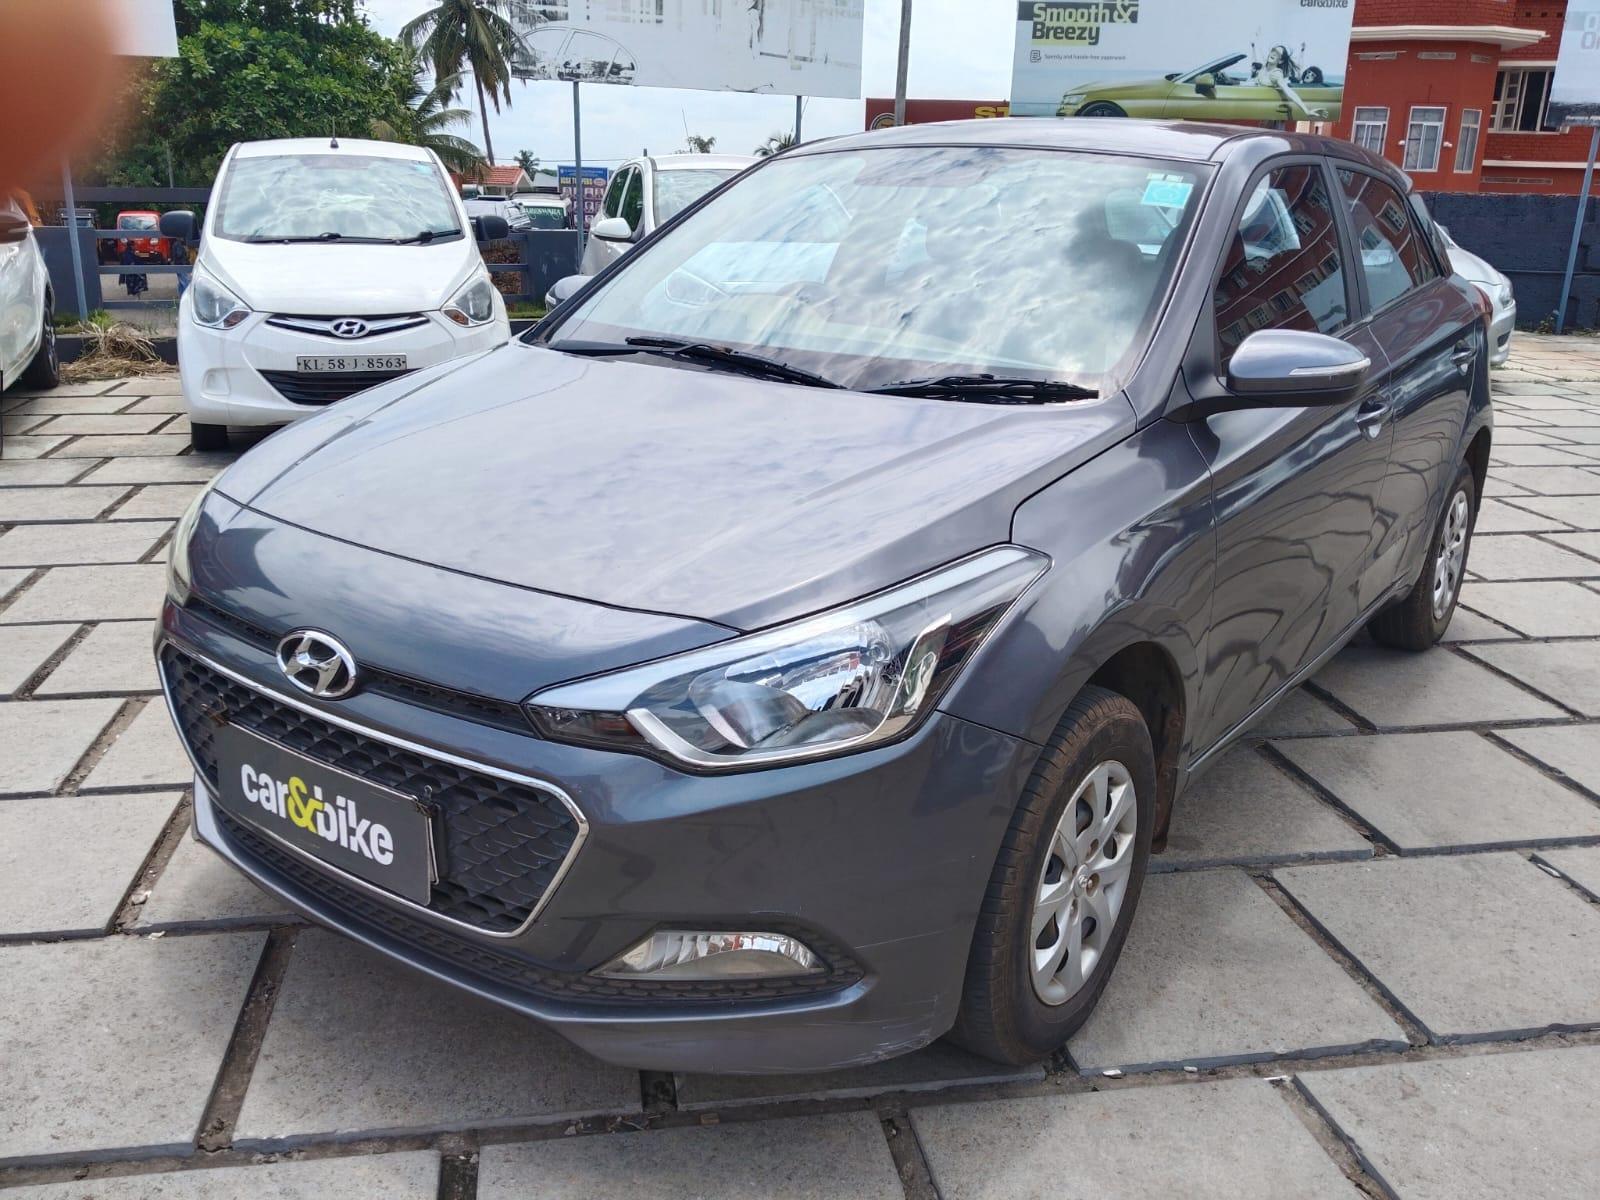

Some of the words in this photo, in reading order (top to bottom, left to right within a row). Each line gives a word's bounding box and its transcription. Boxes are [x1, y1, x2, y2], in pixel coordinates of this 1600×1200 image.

[1031, 21, 1101, 46] Breezy
[328, 359, 346, 370] 58
[366, 357, 402, 369] 8563
[241, 763, 394, 866] car&bike
